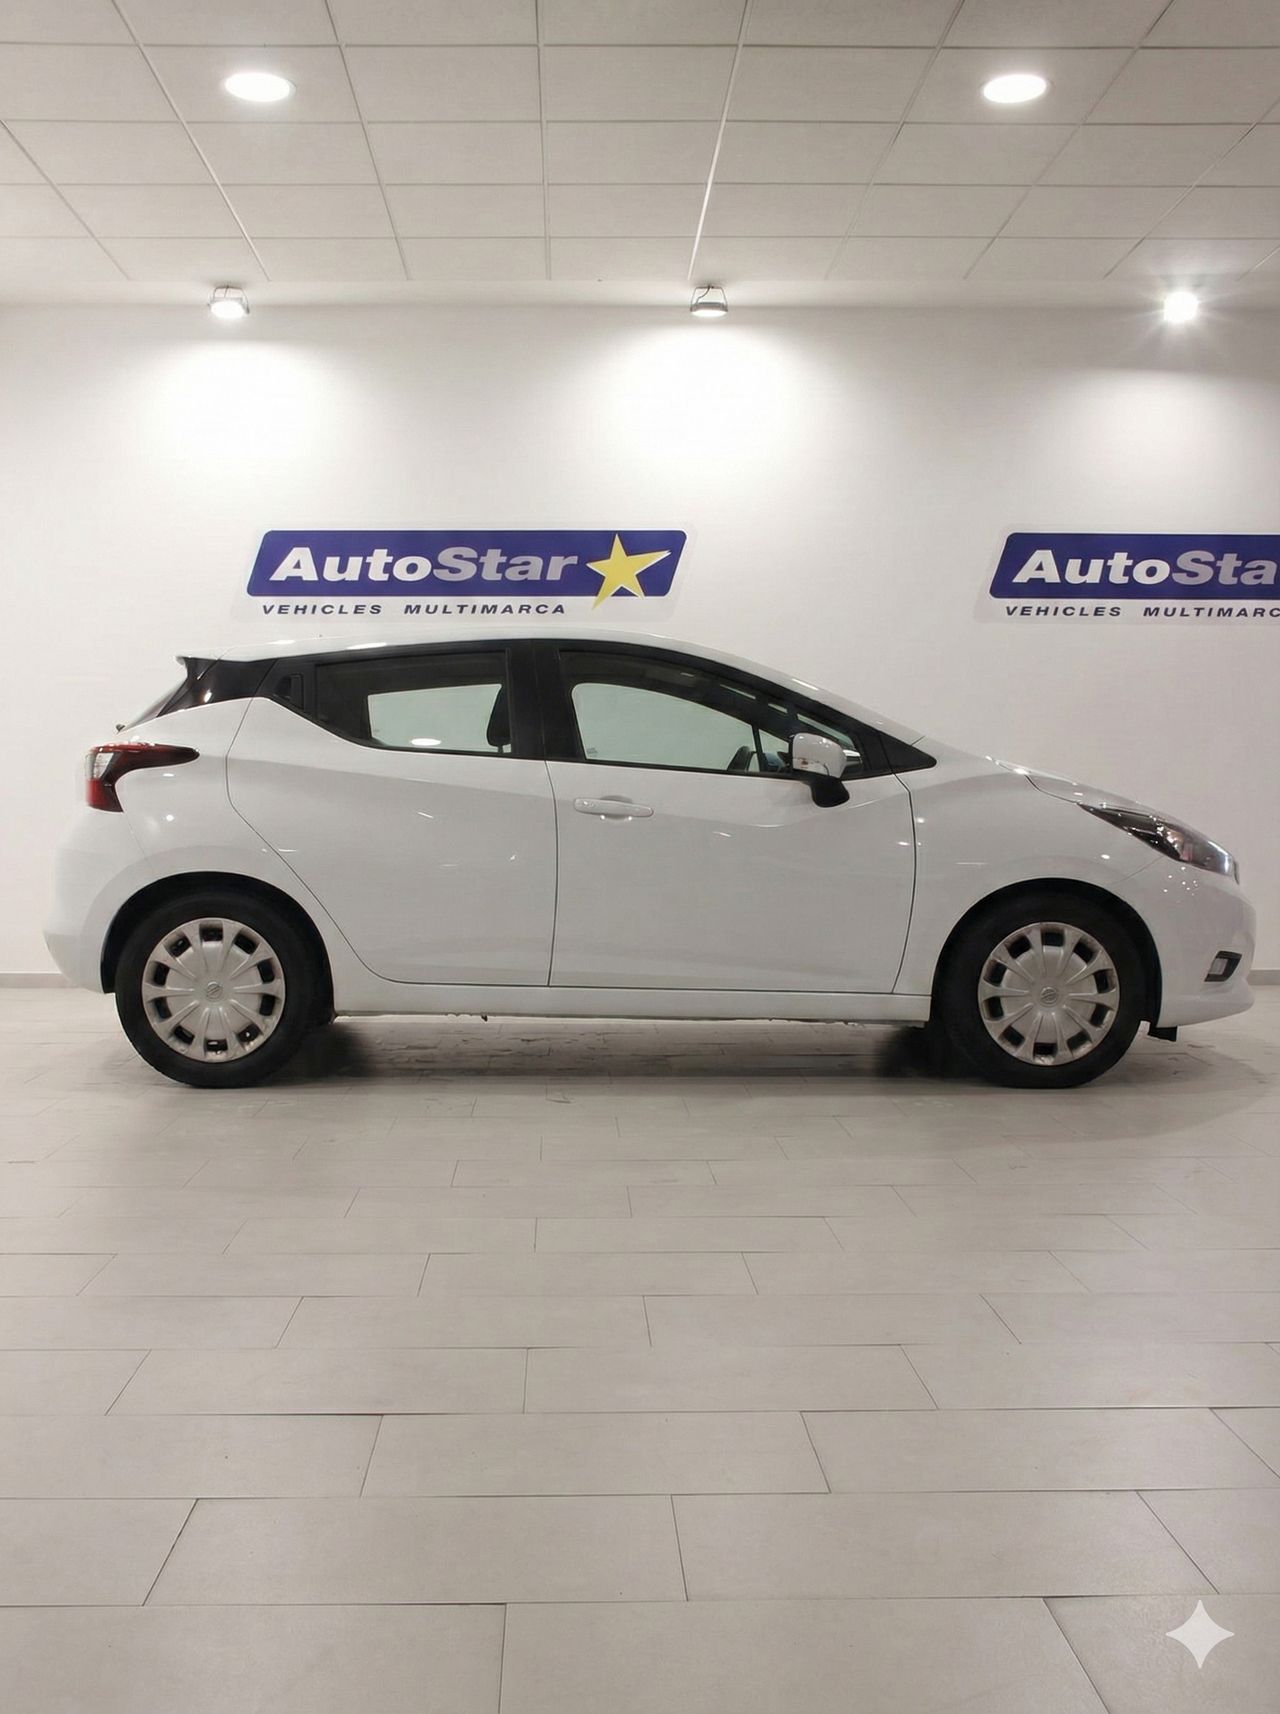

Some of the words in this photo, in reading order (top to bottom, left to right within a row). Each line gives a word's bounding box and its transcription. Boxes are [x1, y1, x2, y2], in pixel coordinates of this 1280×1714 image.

[269, 547, 578, 582] AutoStar
[1012, 549, 1278, 586] AutoSta
[262, 604, 382, 615] VEHICLES
[404, 604, 565, 615] MULTIMARCA
[1006, 606, 1121, 617] VEHICLES
[1143, 607, 1280, 618] MULTIMARC
